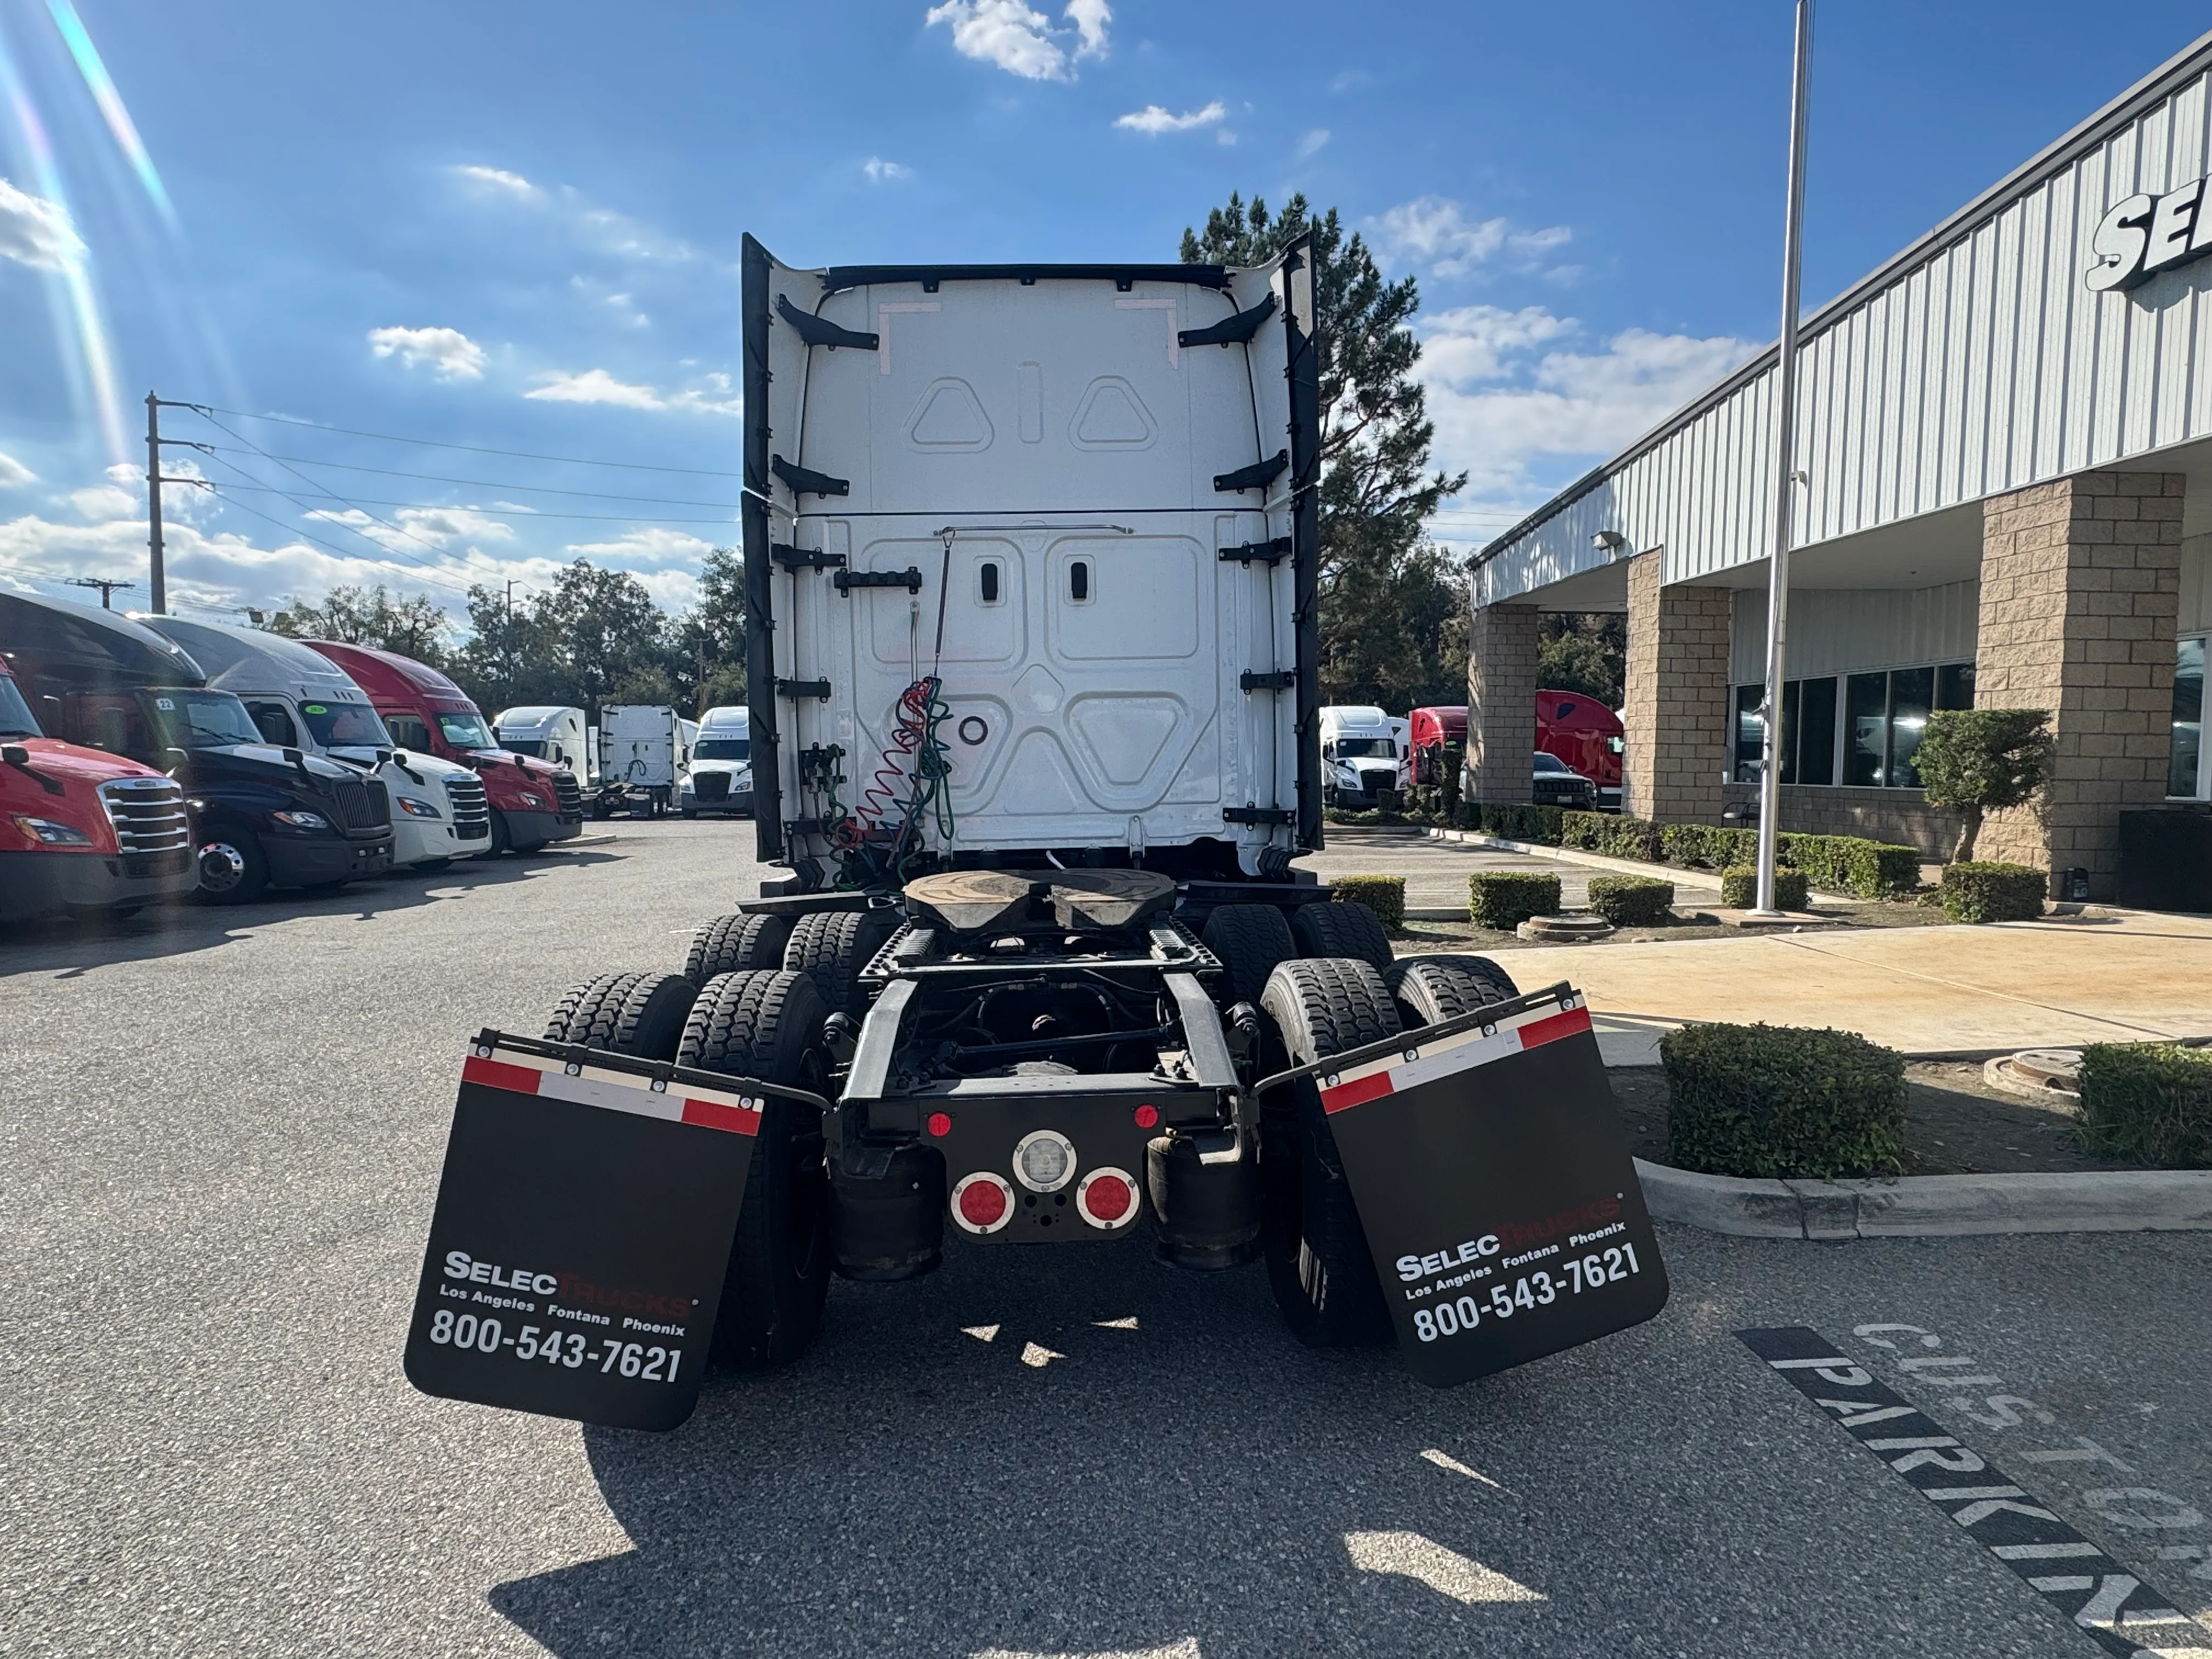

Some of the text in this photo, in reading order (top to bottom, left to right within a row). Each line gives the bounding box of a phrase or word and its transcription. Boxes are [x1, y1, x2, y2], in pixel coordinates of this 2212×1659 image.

[1406, 1221, 1626, 1300] Los Angeles Fontana Phoenix
[1413, 1242, 1639, 1342] 800-543-7621
[430, 1309, 681, 1383] 800-543-7621
[440, 1283, 686, 1337] Los Angeles Fontana Phoenix
[1768, 1357, 2212, 1659] PARKIN
